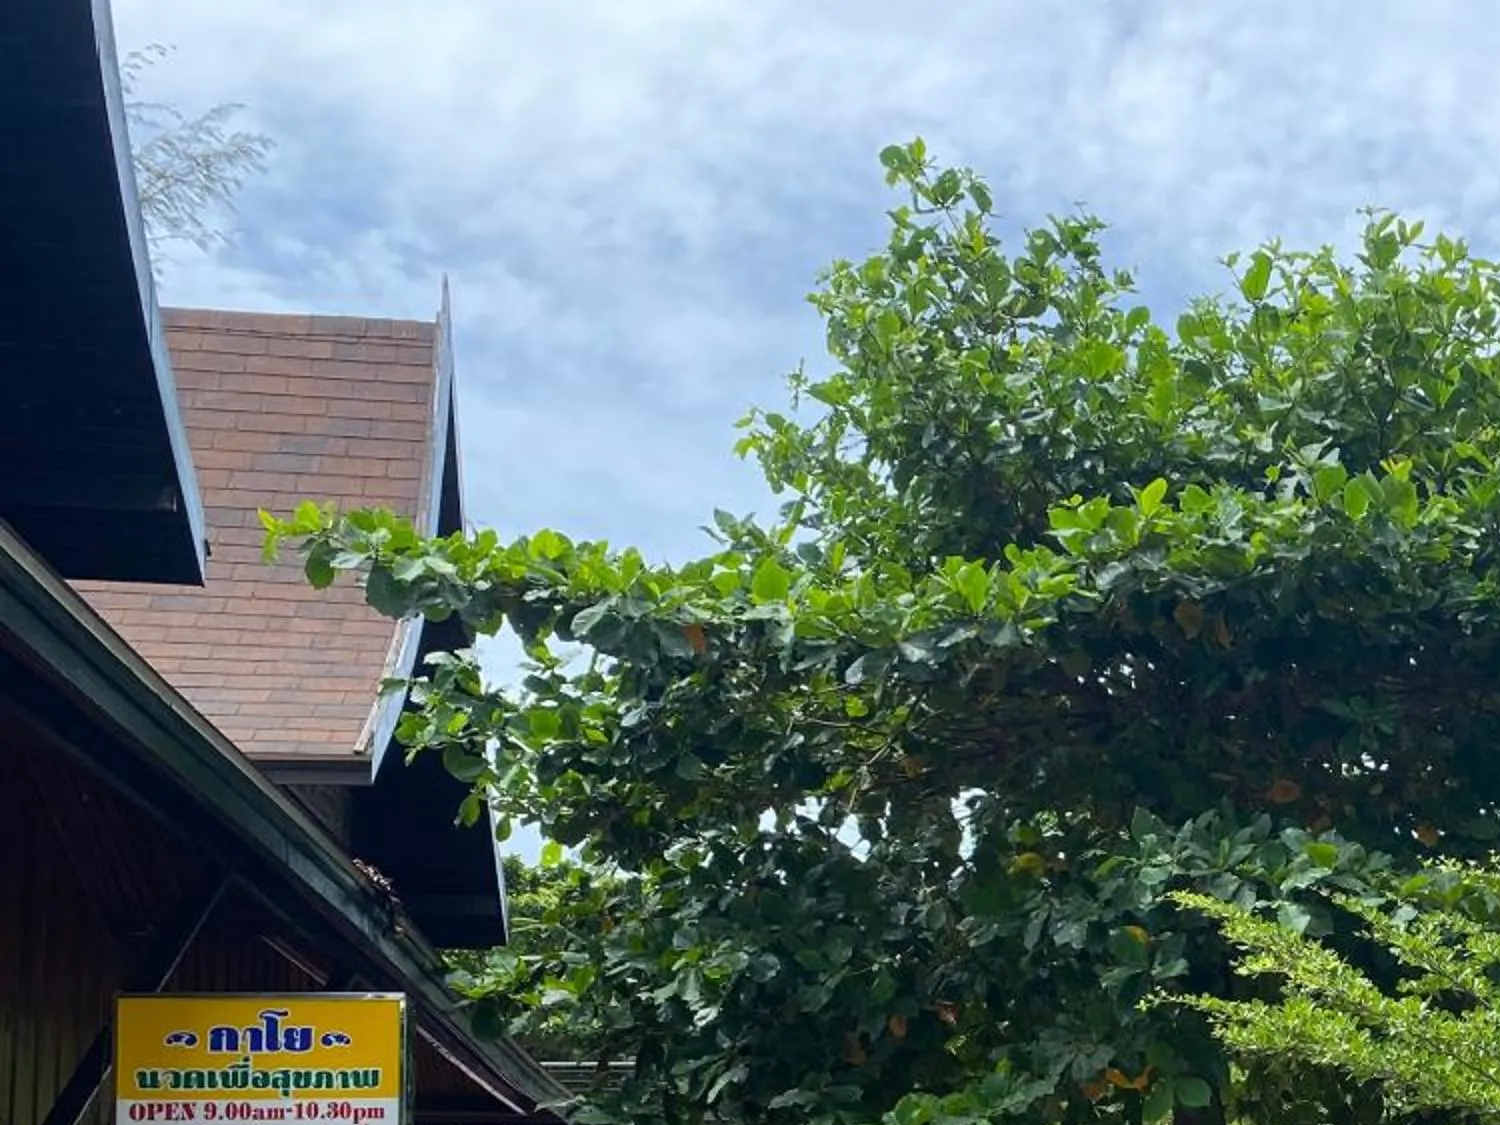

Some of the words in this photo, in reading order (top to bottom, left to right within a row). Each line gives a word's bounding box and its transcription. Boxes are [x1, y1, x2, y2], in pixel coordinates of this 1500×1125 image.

[208, 1010, 313, 1053] กาโย
[136, 1057, 380, 1097] นวดเพื่อสุขภาพ
[129, 1102, 198, 1121] OPEN
